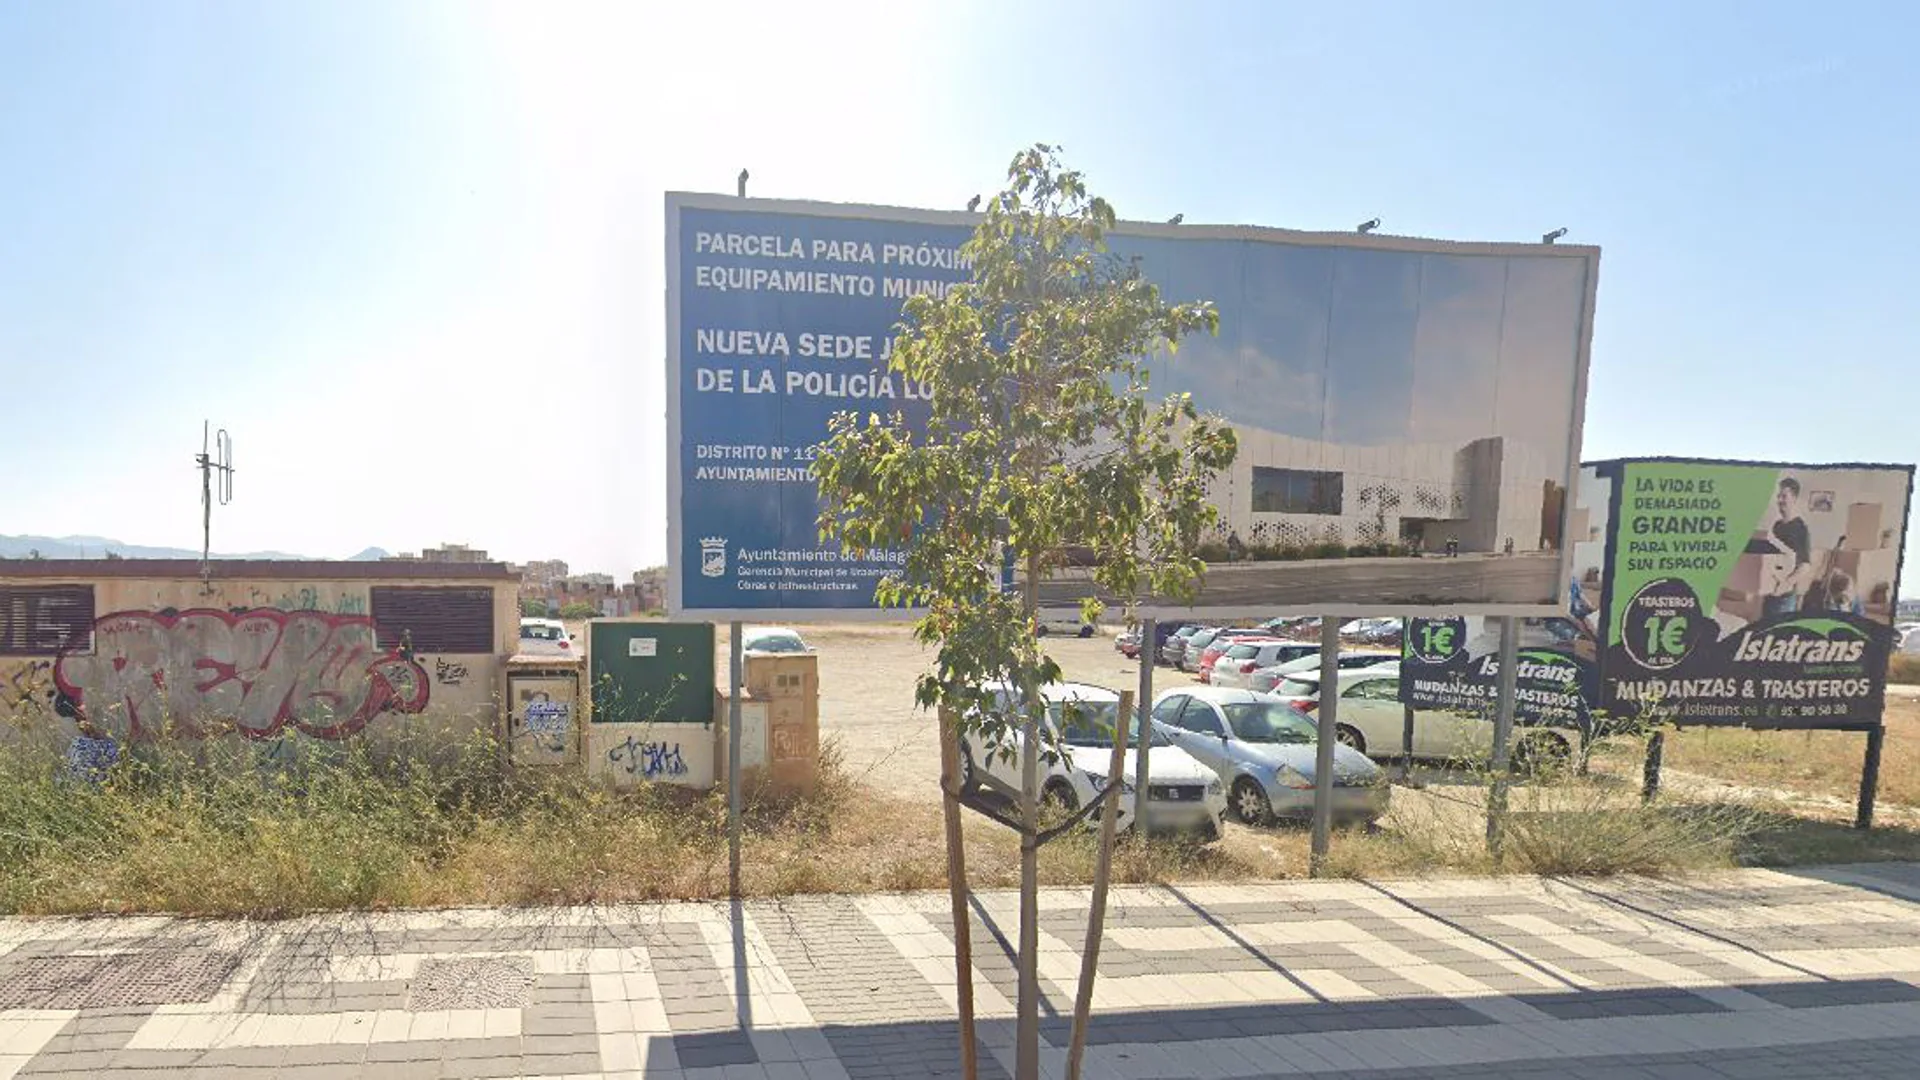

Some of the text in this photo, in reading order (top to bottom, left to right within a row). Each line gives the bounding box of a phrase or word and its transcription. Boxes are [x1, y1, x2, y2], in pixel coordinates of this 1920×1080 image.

[697, 232, 974, 271] PARCELA PARA PRÓXIM
[697, 266, 875, 297] EQUIPAMIENTO
[697, 329, 789, 356] NUEVA
[798, 333, 872, 360] SEDE
[697, 368, 734, 392] DE
[742, 369, 776, 394] LA
[786, 367, 895, 399] POLICÍA
[697, 445, 767, 460] DISTRITO
[1636, 477, 1714, 493] LA VIDA ES
[1635, 498, 1721, 509] DEMASIADO
[1632, 516, 1726, 534] GRANDE
[737, 548, 838, 563] Ayuntamiento
[1630, 541, 1727, 553] PARA VIVIRLA
[1628, 556, 1717, 571] SIN ESPACIO
[1639, 597, 1695, 607] TRASTEROS
[1421, 627, 1455, 654] 1€
[1644, 617, 1688, 655] 1€
[1734, 631, 1865, 662] Islatrans
[1413, 680, 1485, 697] MUDANZAS
[1616, 678, 1870, 700] MUDANZAS & TRASTEROS
